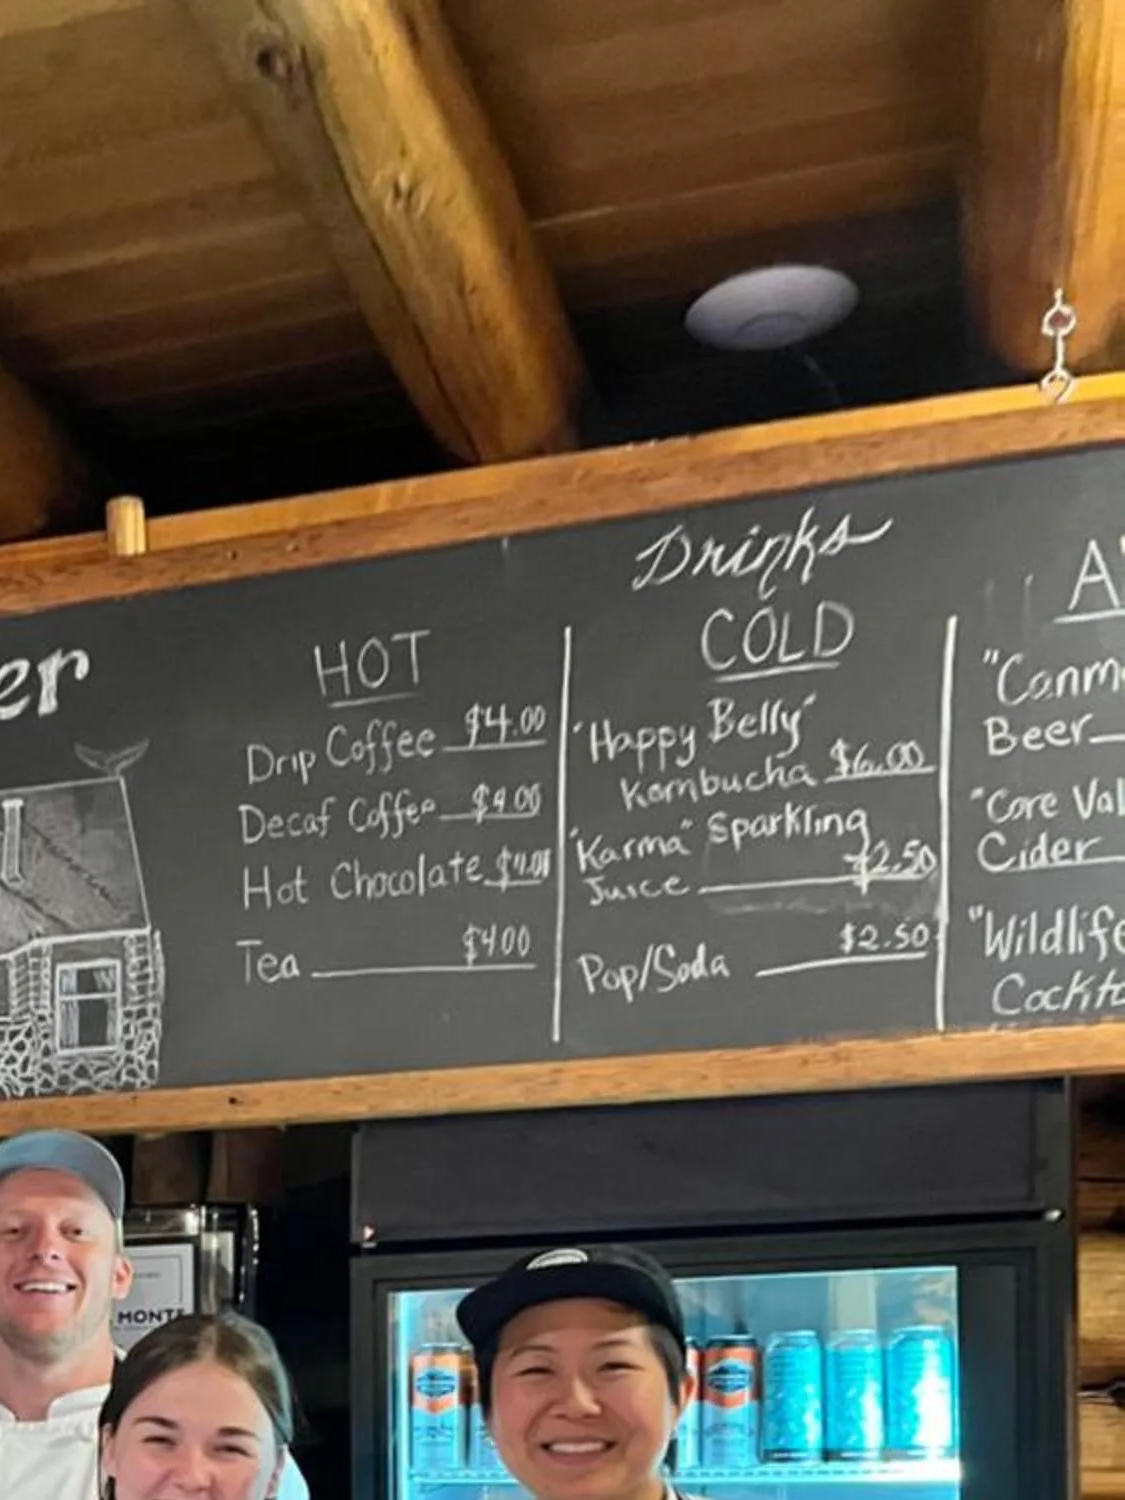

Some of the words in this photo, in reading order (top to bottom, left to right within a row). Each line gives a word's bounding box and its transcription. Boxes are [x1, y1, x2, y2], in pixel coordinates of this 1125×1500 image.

[632, 506, 893, 600] Drinks
[1068, 536, 1125, 611] A
[315, 629, 431, 697] HOT
[700, 601, 855, 671] COLD
[246, 743, 316, 786] Drip
[326, 718, 436, 775] Coffee
[463, 702, 547, 749] $4.00
[829, 738, 925, 779] $6.00
[983, 712, 1094, 757] Beer
[238, 797, 337, 845] Decaf
[348, 788, 436, 840] Coffee
[707, 801, 872, 860] Sparkling
[977, 830, 1104, 873] Cider
[244, 864, 309, 910] Hot
[330, 852, 484, 900] Chocolate
[584, 875, 691, 906] Juice
[236, 938, 301, 984] Tea
[578, 943, 730, 1003] Pop/Soda
[840, 921, 929, 953] $2.50
